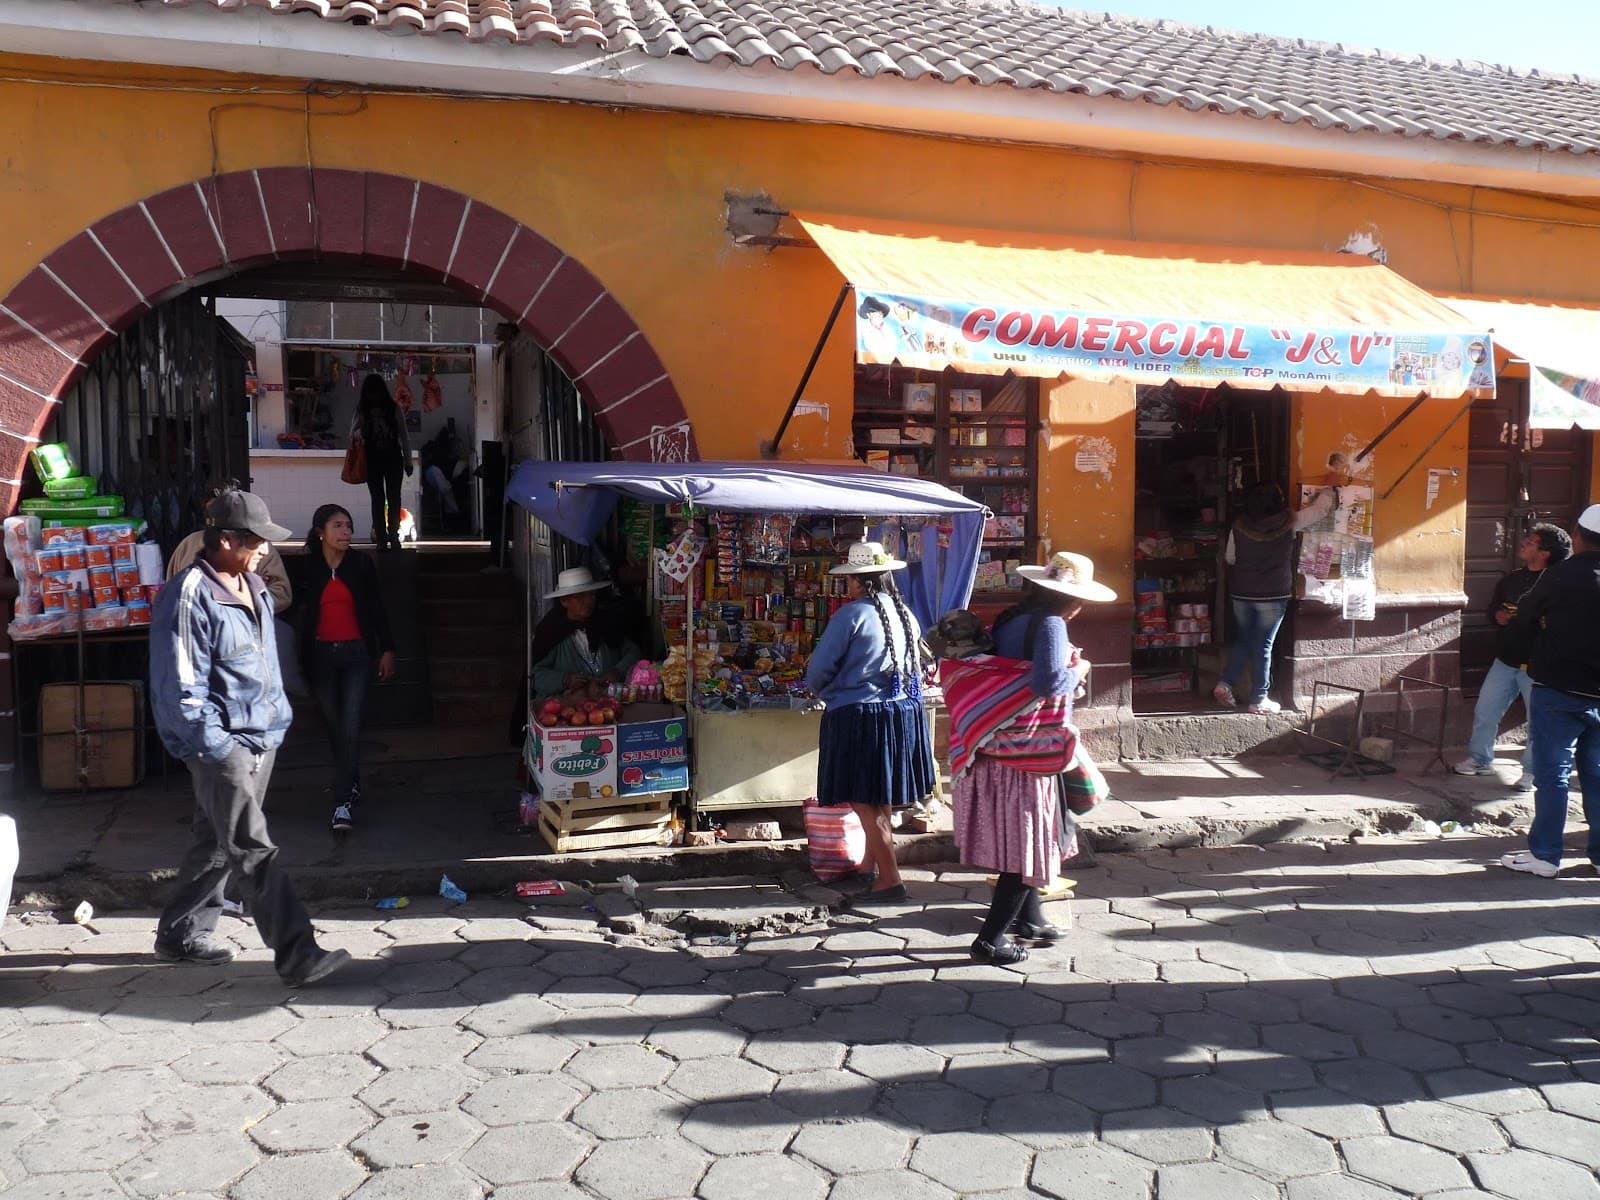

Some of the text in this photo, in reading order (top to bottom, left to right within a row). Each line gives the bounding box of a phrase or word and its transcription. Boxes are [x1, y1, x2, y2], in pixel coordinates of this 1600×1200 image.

[961, 308, 1249, 359] COMERCIAL
[993, 352, 1027, 362] UHU
[1134, 362, 1171, 372] LIDER
[1243, 367, 1274, 378] TOP
[1279, 370, 1331, 381] MonAmi
[559, 758, 600, 772] Febita
